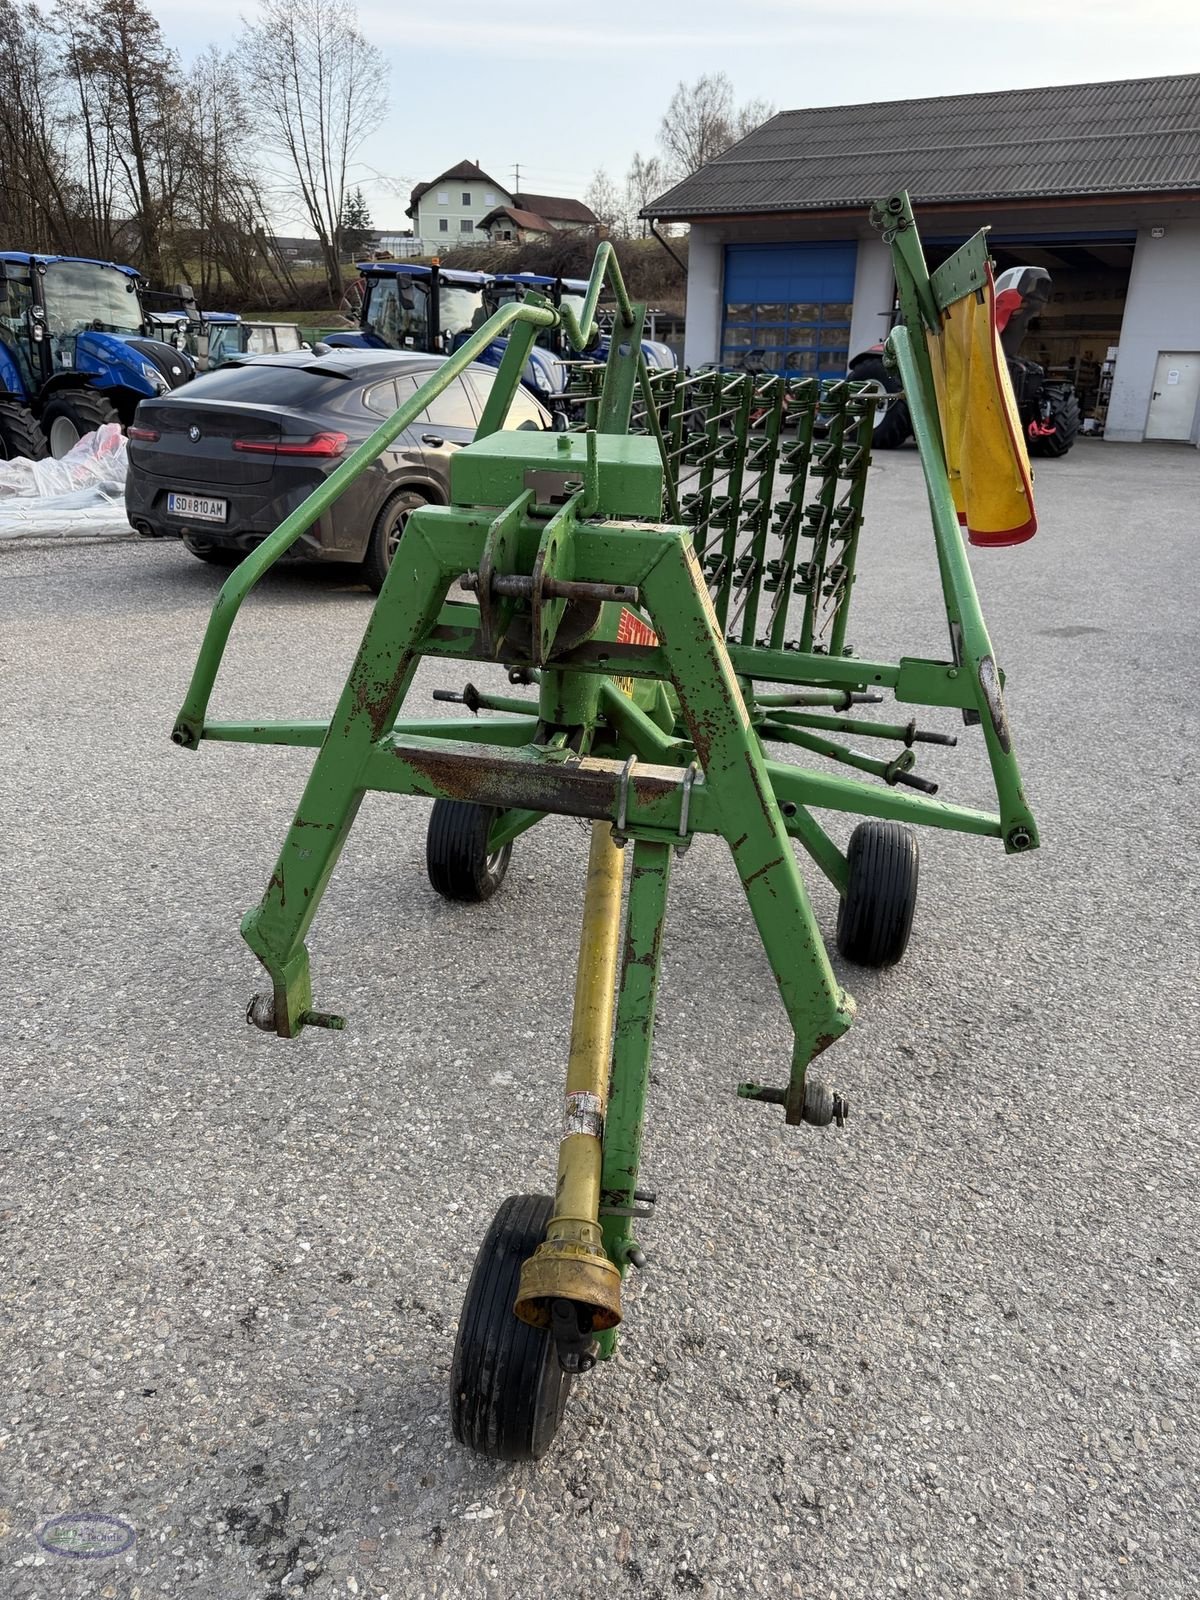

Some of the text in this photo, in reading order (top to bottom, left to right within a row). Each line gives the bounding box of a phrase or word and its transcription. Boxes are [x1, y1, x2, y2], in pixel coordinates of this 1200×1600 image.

[176, 497, 223, 515] SD 810 AM
